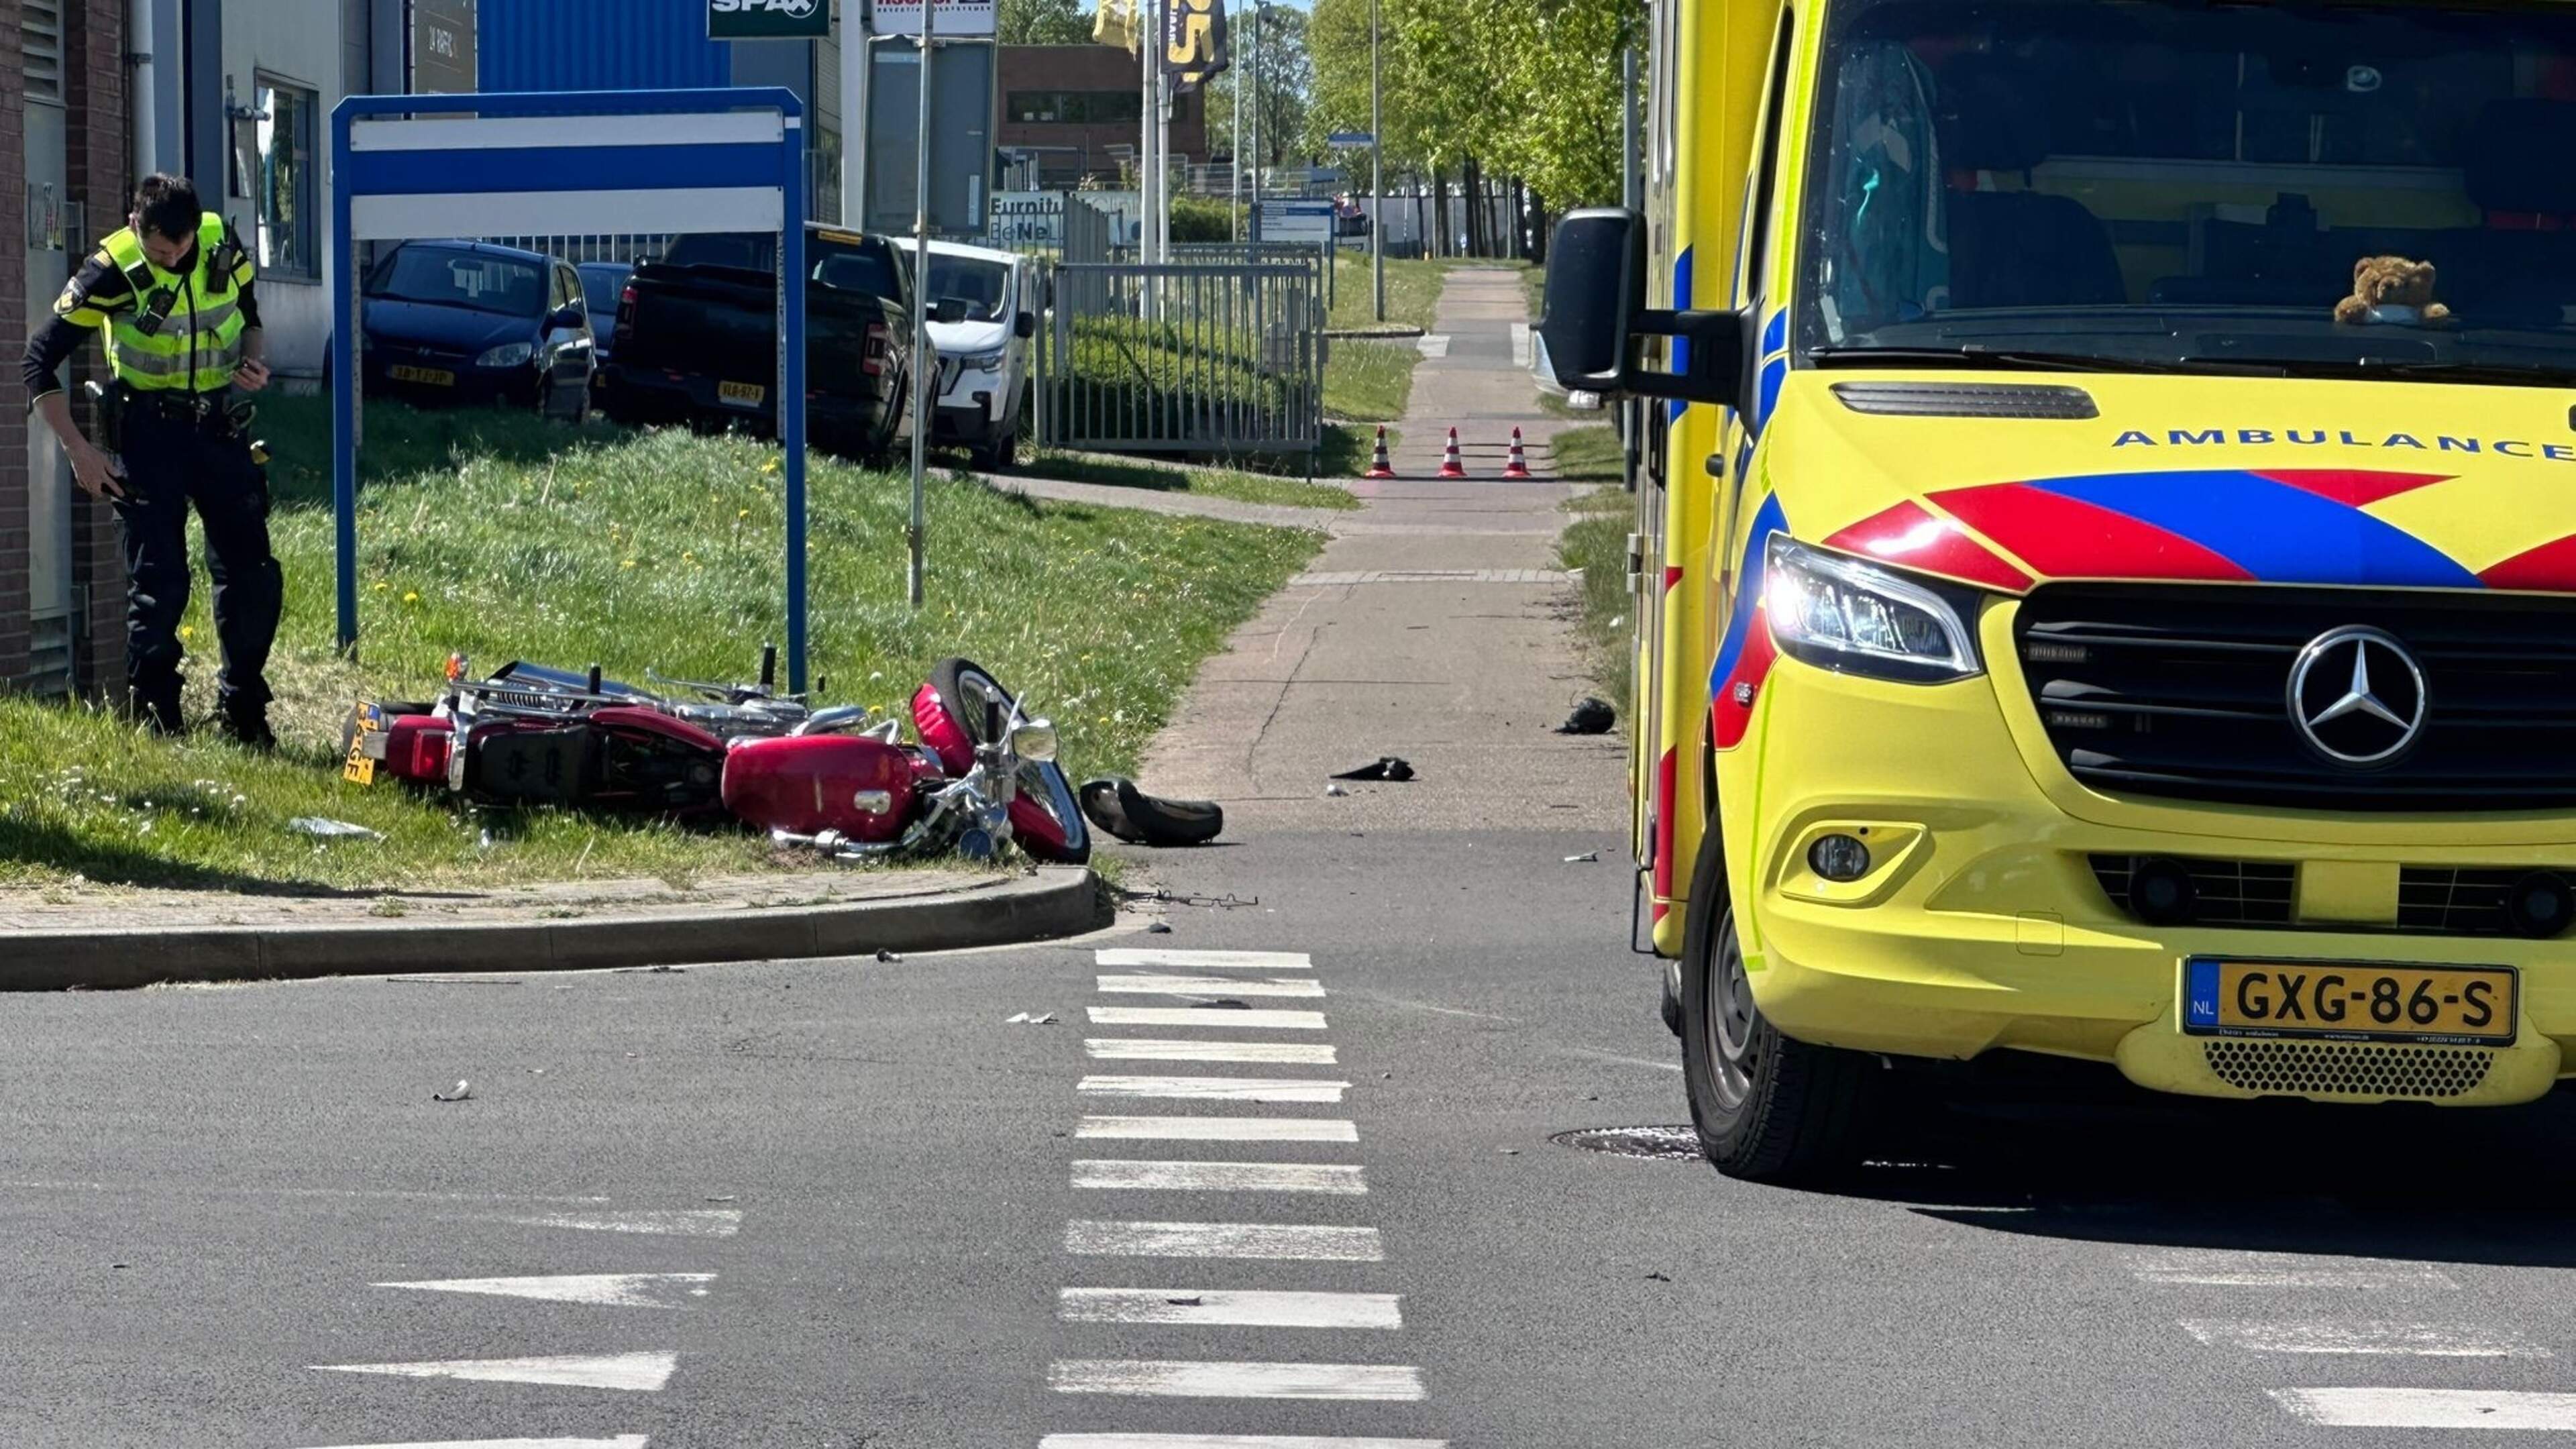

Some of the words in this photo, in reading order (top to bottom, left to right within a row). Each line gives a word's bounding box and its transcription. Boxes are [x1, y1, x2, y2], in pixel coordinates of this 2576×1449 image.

[991, 197, 1063, 215] Furnitu
[991, 222, 1059, 240] BeNeL
[2112, 429, 2576, 461] AMBULANCE
[2194, 1001, 2214, 1015] NL
[2237, 972, 2493, 1027] GXG-86-S
